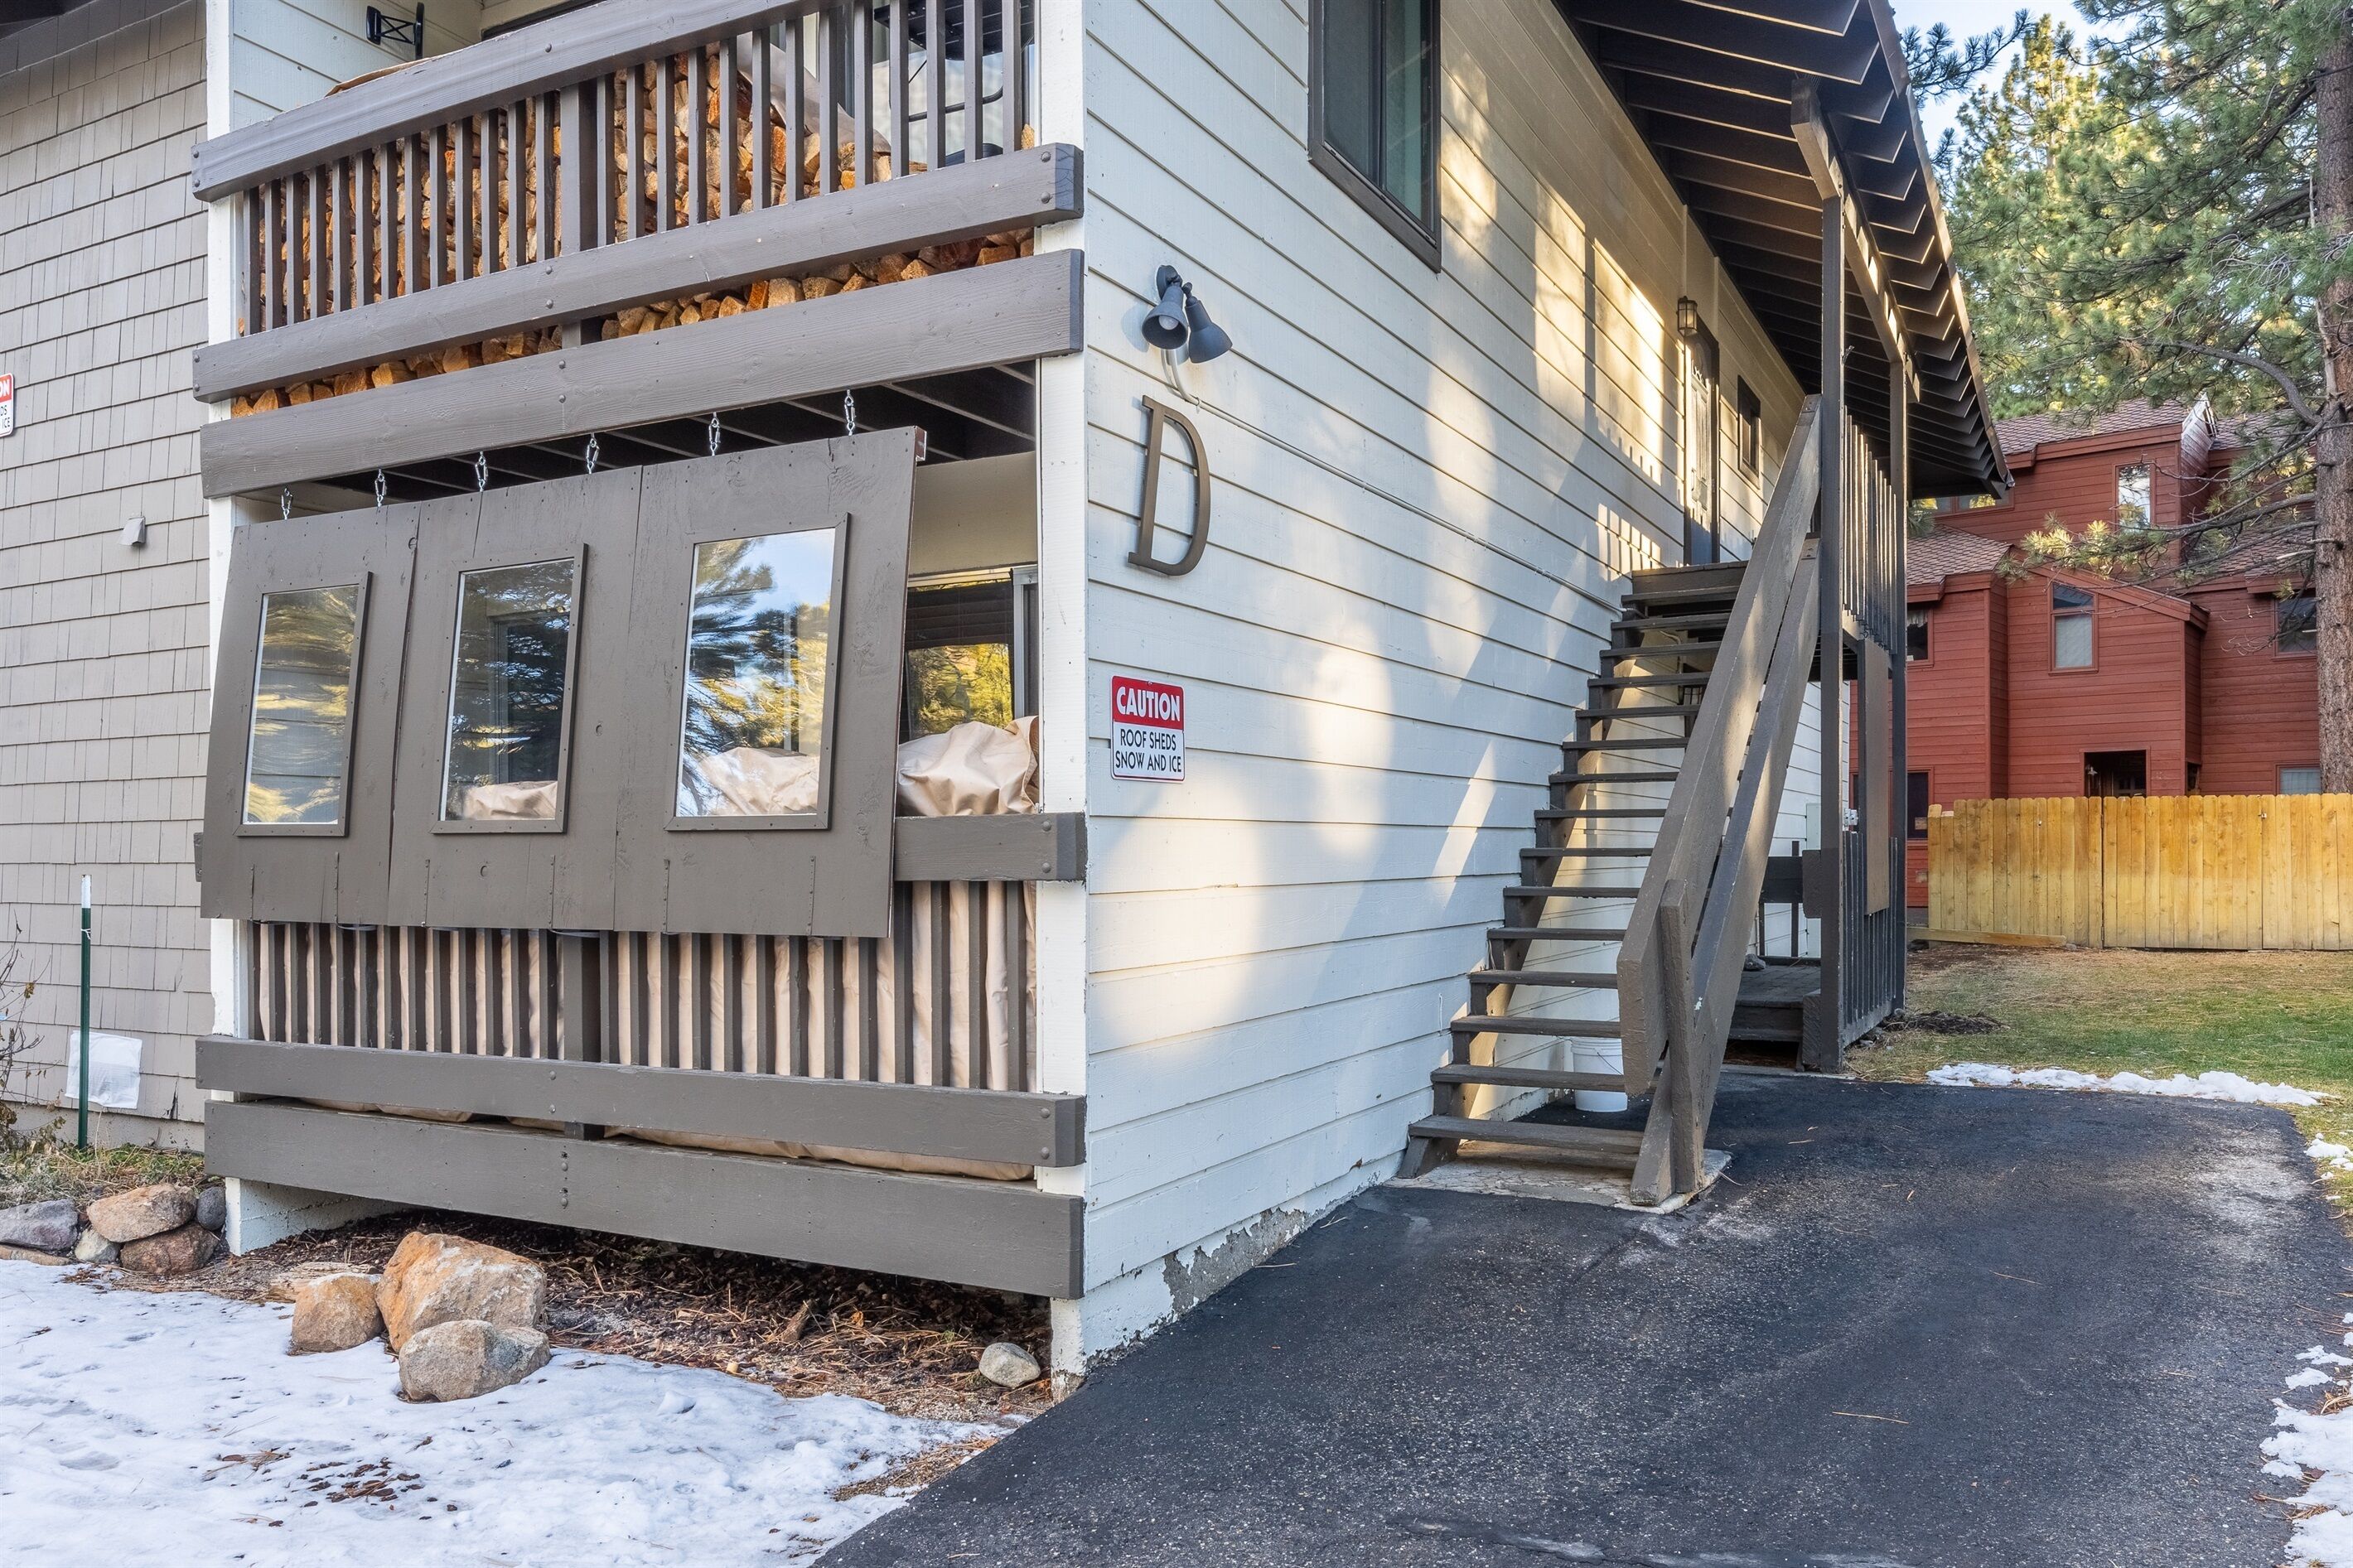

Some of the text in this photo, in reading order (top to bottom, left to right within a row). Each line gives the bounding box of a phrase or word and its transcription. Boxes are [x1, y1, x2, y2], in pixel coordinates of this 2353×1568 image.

[1128, 395, 1210, 576] D
[1116, 687, 1180, 721] CAUTION
[1120, 729, 1176, 751] ROOF SHEDS
[1115, 750, 1181, 772] SNOW AND ICE
